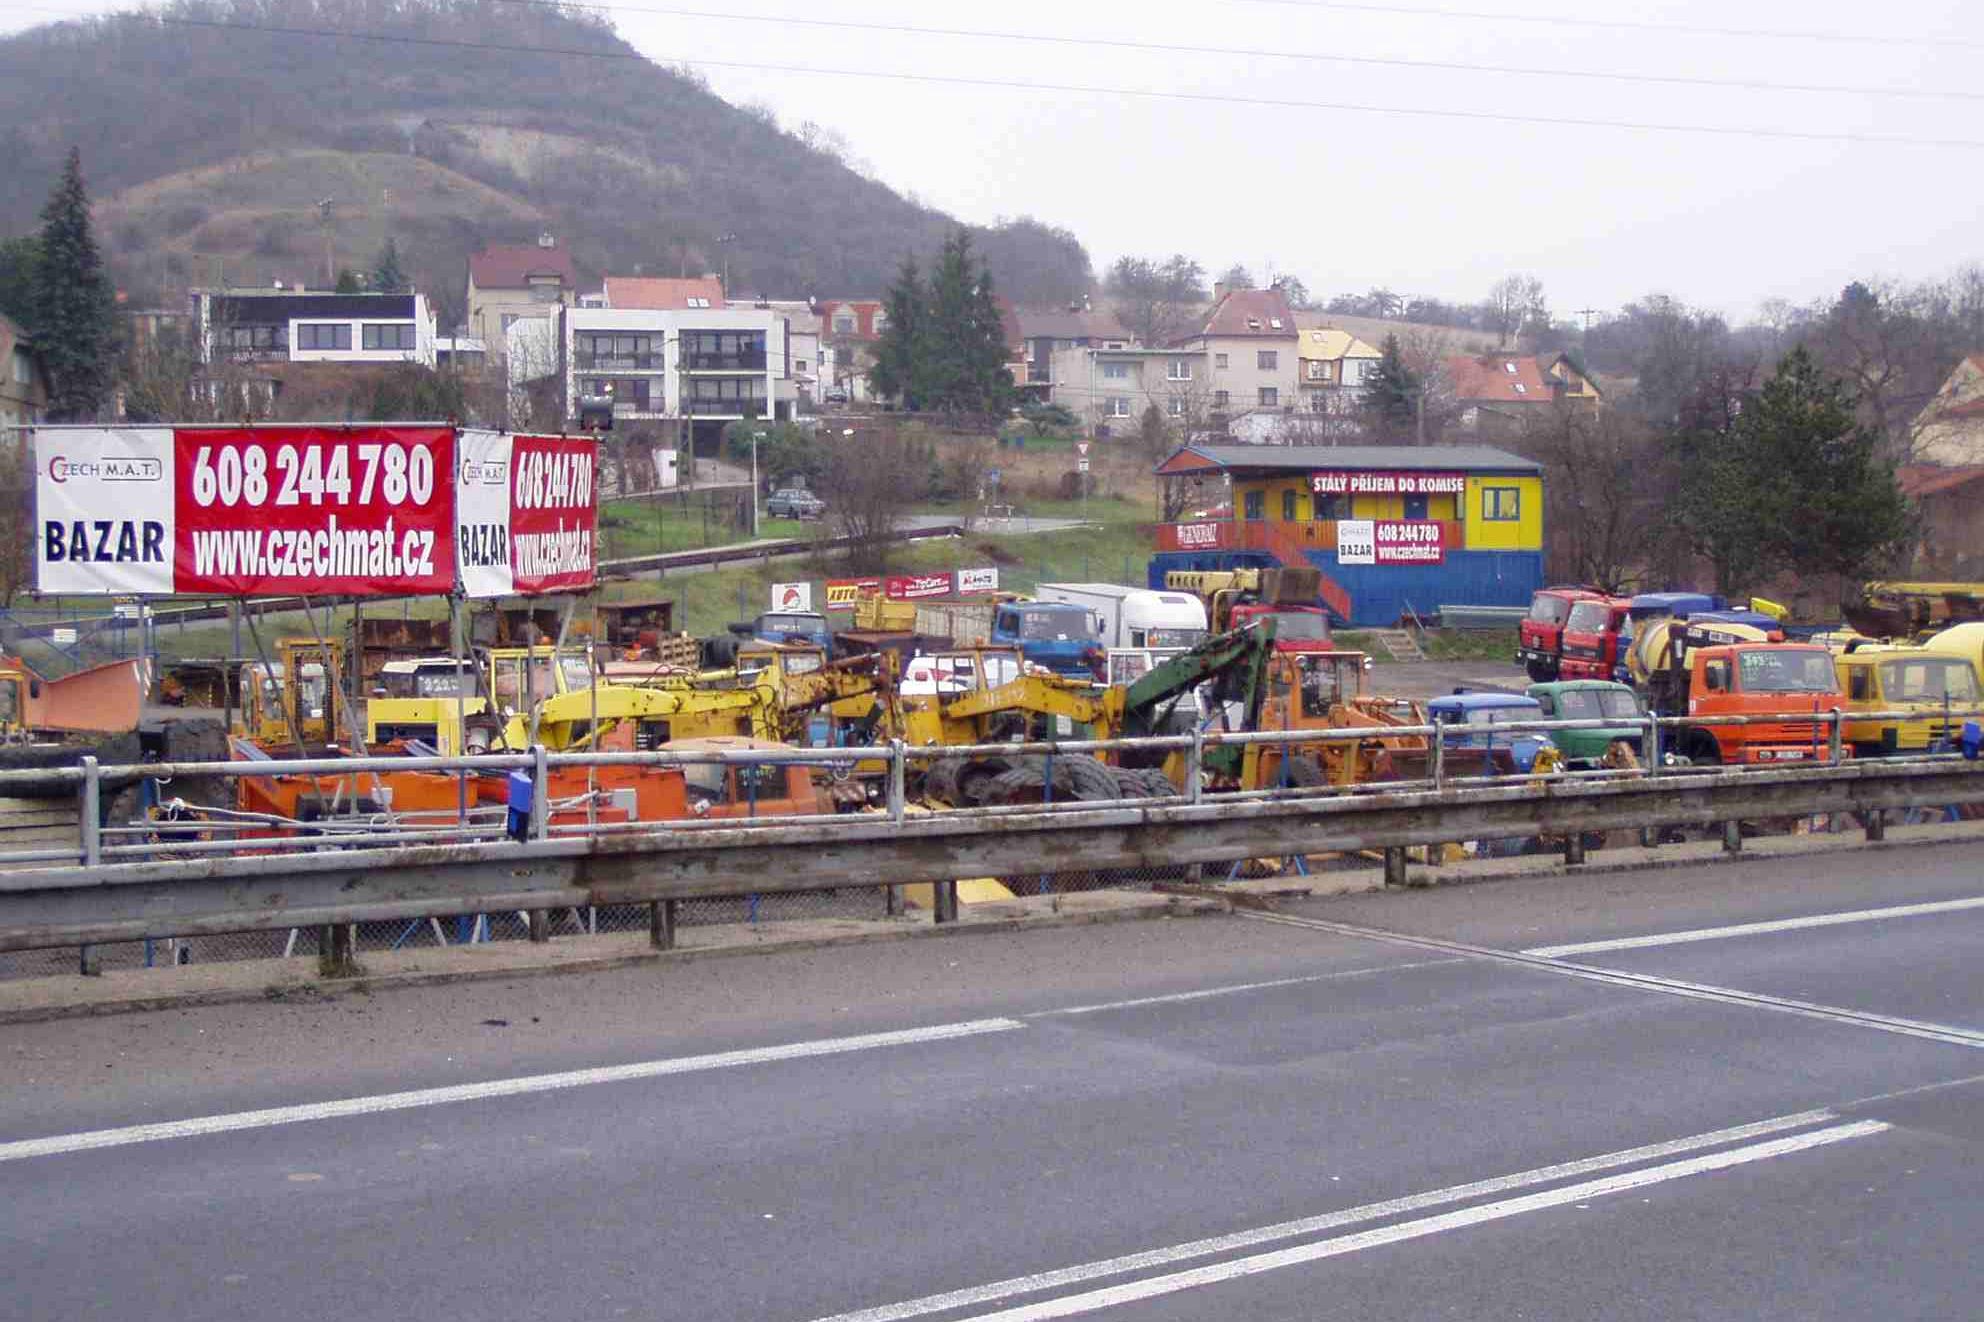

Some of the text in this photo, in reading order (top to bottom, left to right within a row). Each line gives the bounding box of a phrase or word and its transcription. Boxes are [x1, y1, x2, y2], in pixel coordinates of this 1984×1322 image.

[50, 455, 155, 483] CZECH M.A.T.
[192, 443, 434, 507] 608 244 780
[569, 452, 592, 508] 780
[1313, 474, 1464, 492] STÁLÝ PŘÍJEM DO KOMISE
[45, 520, 165, 562] BAZAR
[192, 514, 435, 577] www.czechmat.cz
[460, 524, 507, 567] BAZAR
[1340, 544, 1372, 556] BAZAR
[1377, 524, 1397, 542] 608
[1398, 524, 1418, 541] 244
[1418, 524, 1439, 542] 780
